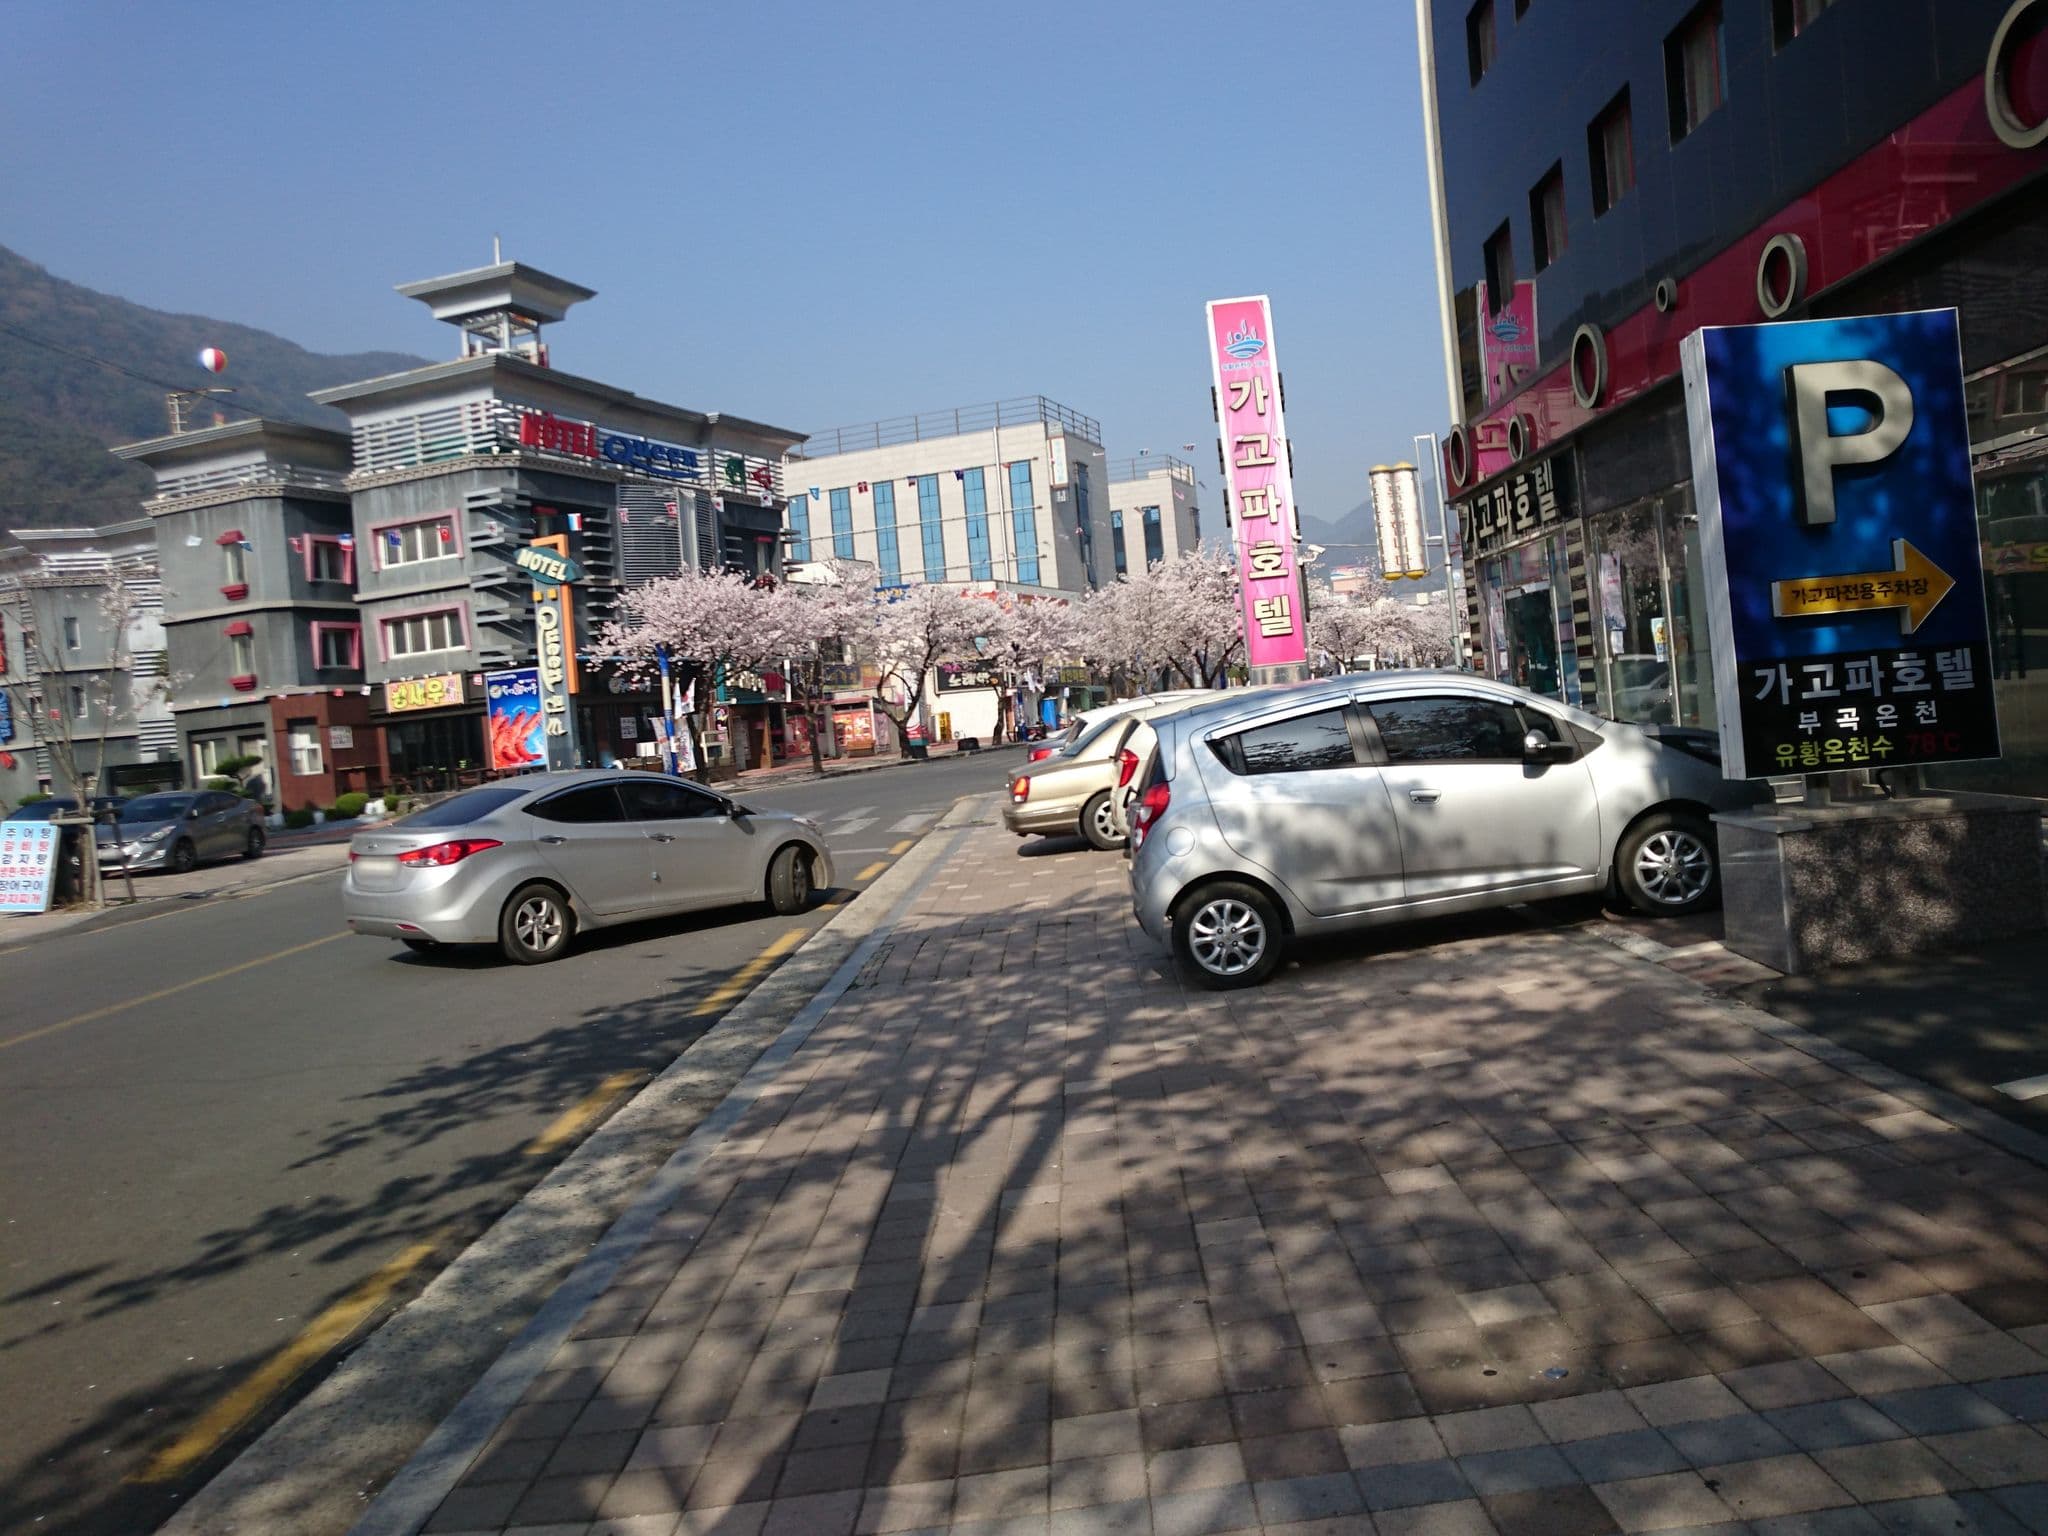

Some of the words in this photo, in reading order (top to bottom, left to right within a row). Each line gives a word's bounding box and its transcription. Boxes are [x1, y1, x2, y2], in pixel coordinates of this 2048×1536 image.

[520, 411, 599, 458] MOTEL
[603, 434, 701, 478] Queen
[1784, 359, 1914, 525] P
[1229, 376, 1295, 638] 가고파호텔
[1457, 458, 1557, 556] 가고파호텔
[517, 549, 567, 582] MOTEL
[1791, 578, 1929, 606] 가고파전용주차장
[537, 606, 563, 693] Queen
[1755, 648, 1976, 705] 가고파호텔
[1798, 700, 1938, 736] 부곡온천
[1775, 735, 1895, 768] 유황온천수
